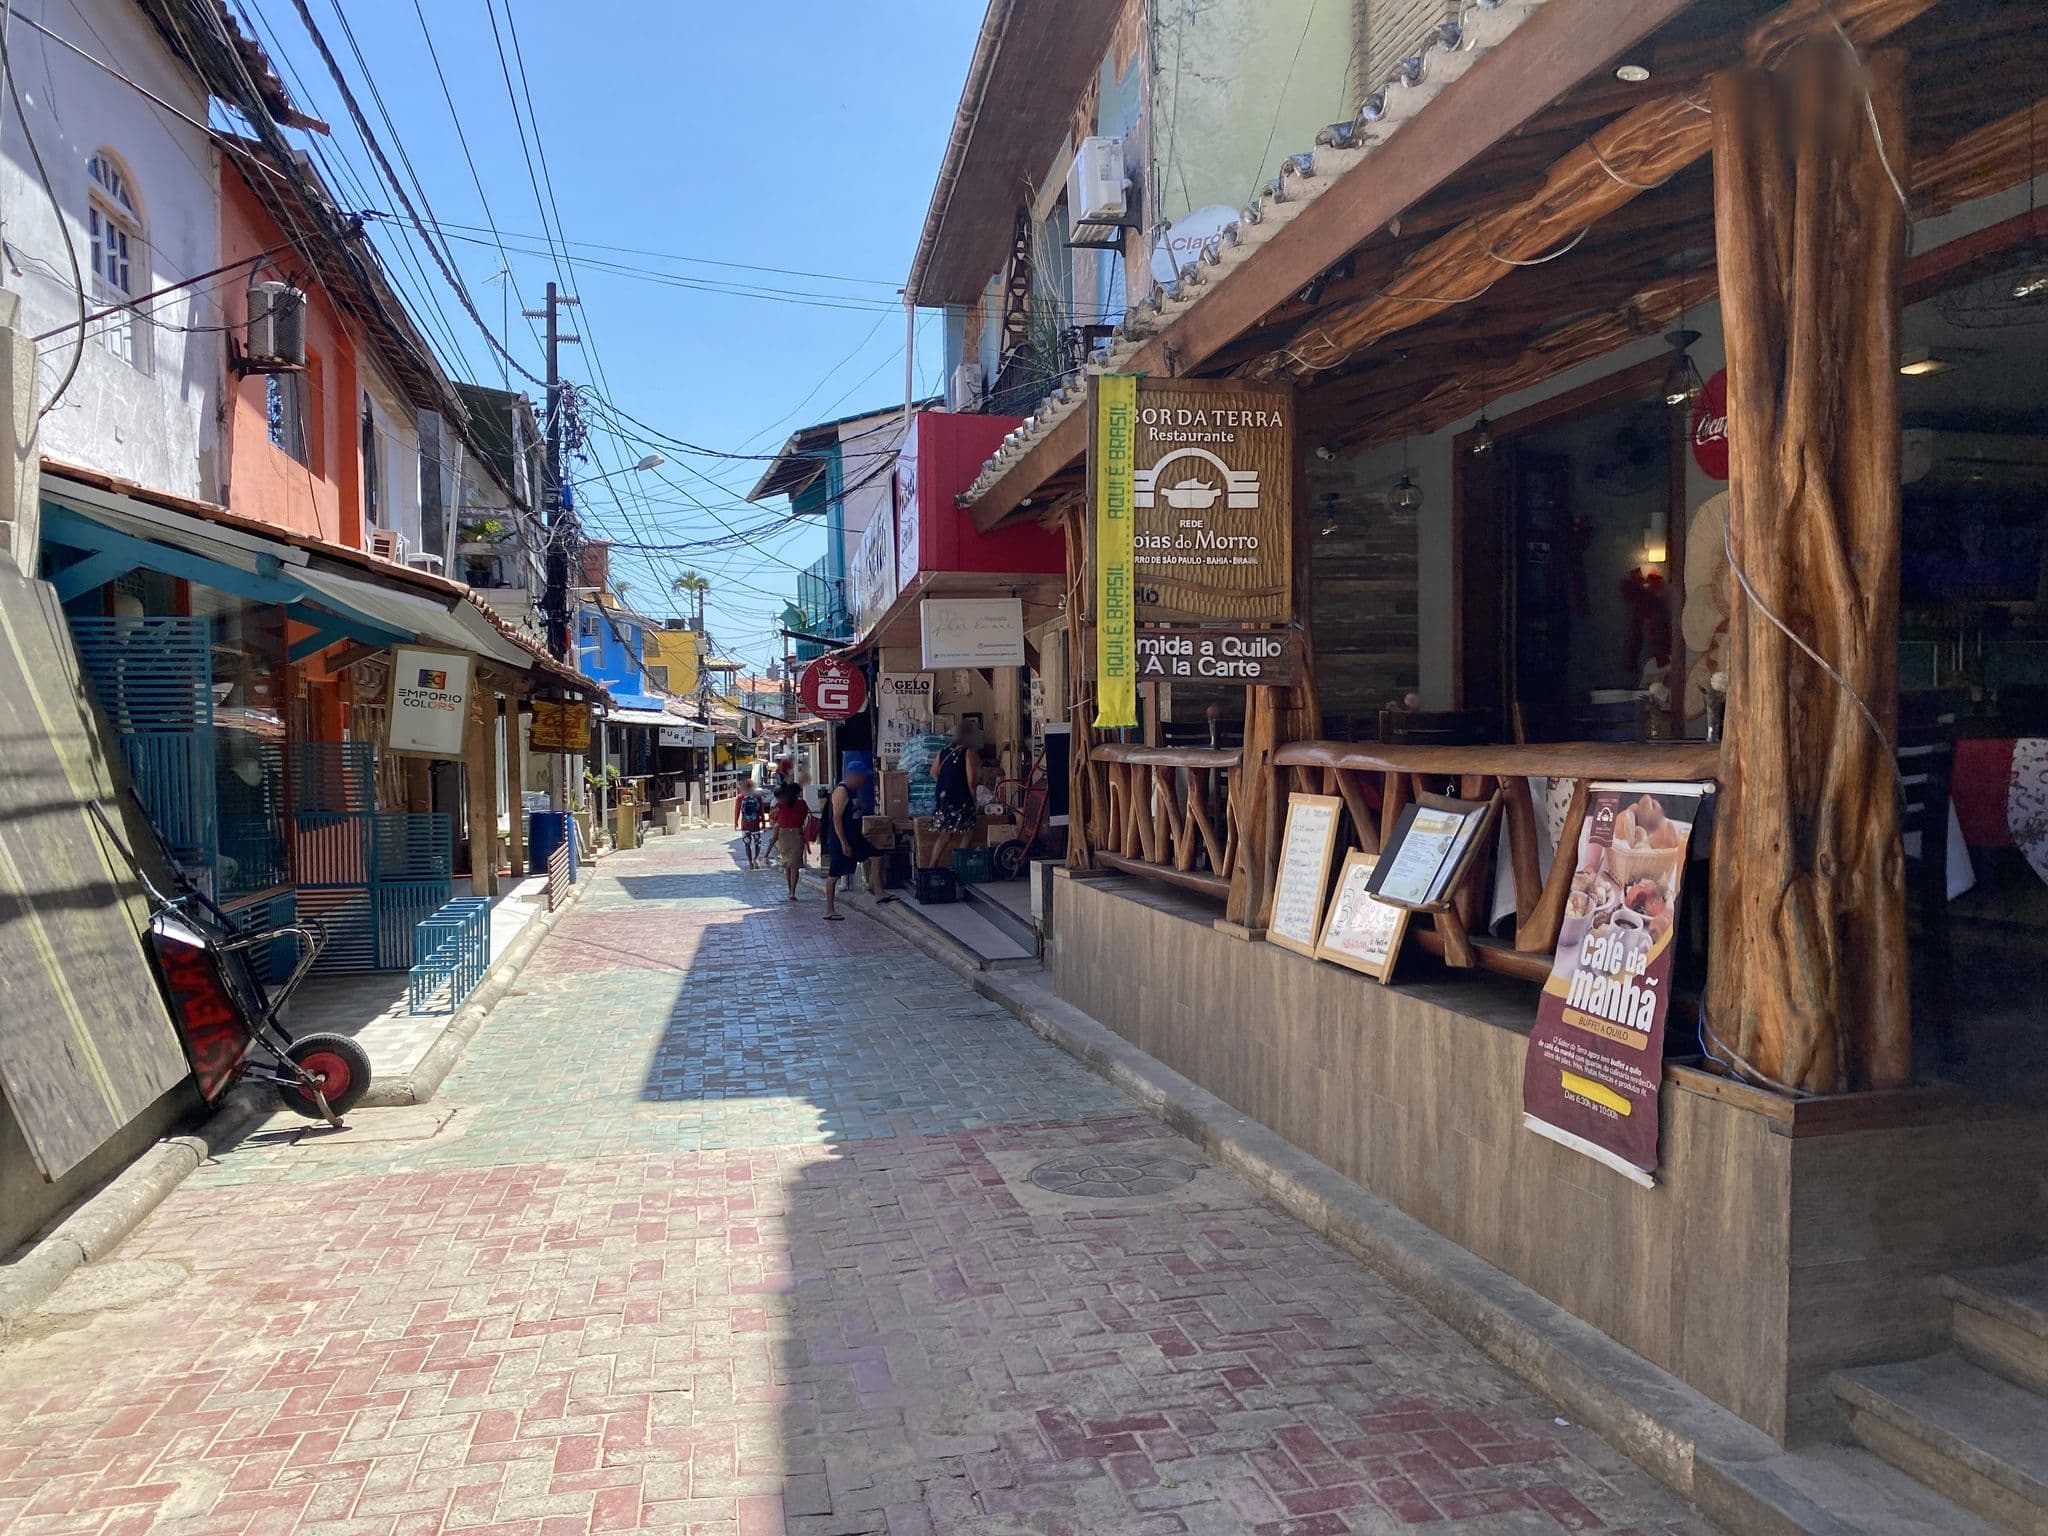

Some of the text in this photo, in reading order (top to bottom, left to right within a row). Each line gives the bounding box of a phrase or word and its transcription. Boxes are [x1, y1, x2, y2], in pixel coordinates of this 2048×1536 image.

[1172, 232, 1221, 250] Claro
[1177, 409, 1208, 426] DA
[1212, 410, 1283, 427] TERRA
[1150, 427, 1235, 442] Restaurante
[1105, 403, 1127, 519] AQUI É BRASIL
[1179, 520, 1204, 528] REDE
[1134, 530, 1259, 549] oias do Morro
[1134, 555, 1150, 564] RRO
[1151, 556, 1161, 564] DE
[1162, 554, 1177, 564] SÃO
[1178, 556, 1202, 565] PAULO
[1206, 556, 1229, 565] BAHIA
[1103, 564, 1124, 677] AQUI É BRASIL
[1135, 636, 1282, 658] mida a Quilo
[1144, 651, 1164, 675] À
[1172, 657, 1191, 676] la
[1198, 656, 1261, 677] Carte
[818, 677, 850, 685] PONTO
[894, 680, 930, 690] GELO
[398, 688, 463, 703] EMPORIO
[817, 684, 849, 709] G
[403, 698, 455, 712] COLORS
[1581, 931, 1648, 976] café da
[1566, 968, 1659, 1033] manhã
[1579, 1016, 1601, 1031] BUFFET
[1605, 1026, 1629, 1041] QUILO
[1564, 1089, 1575, 1101] Das
